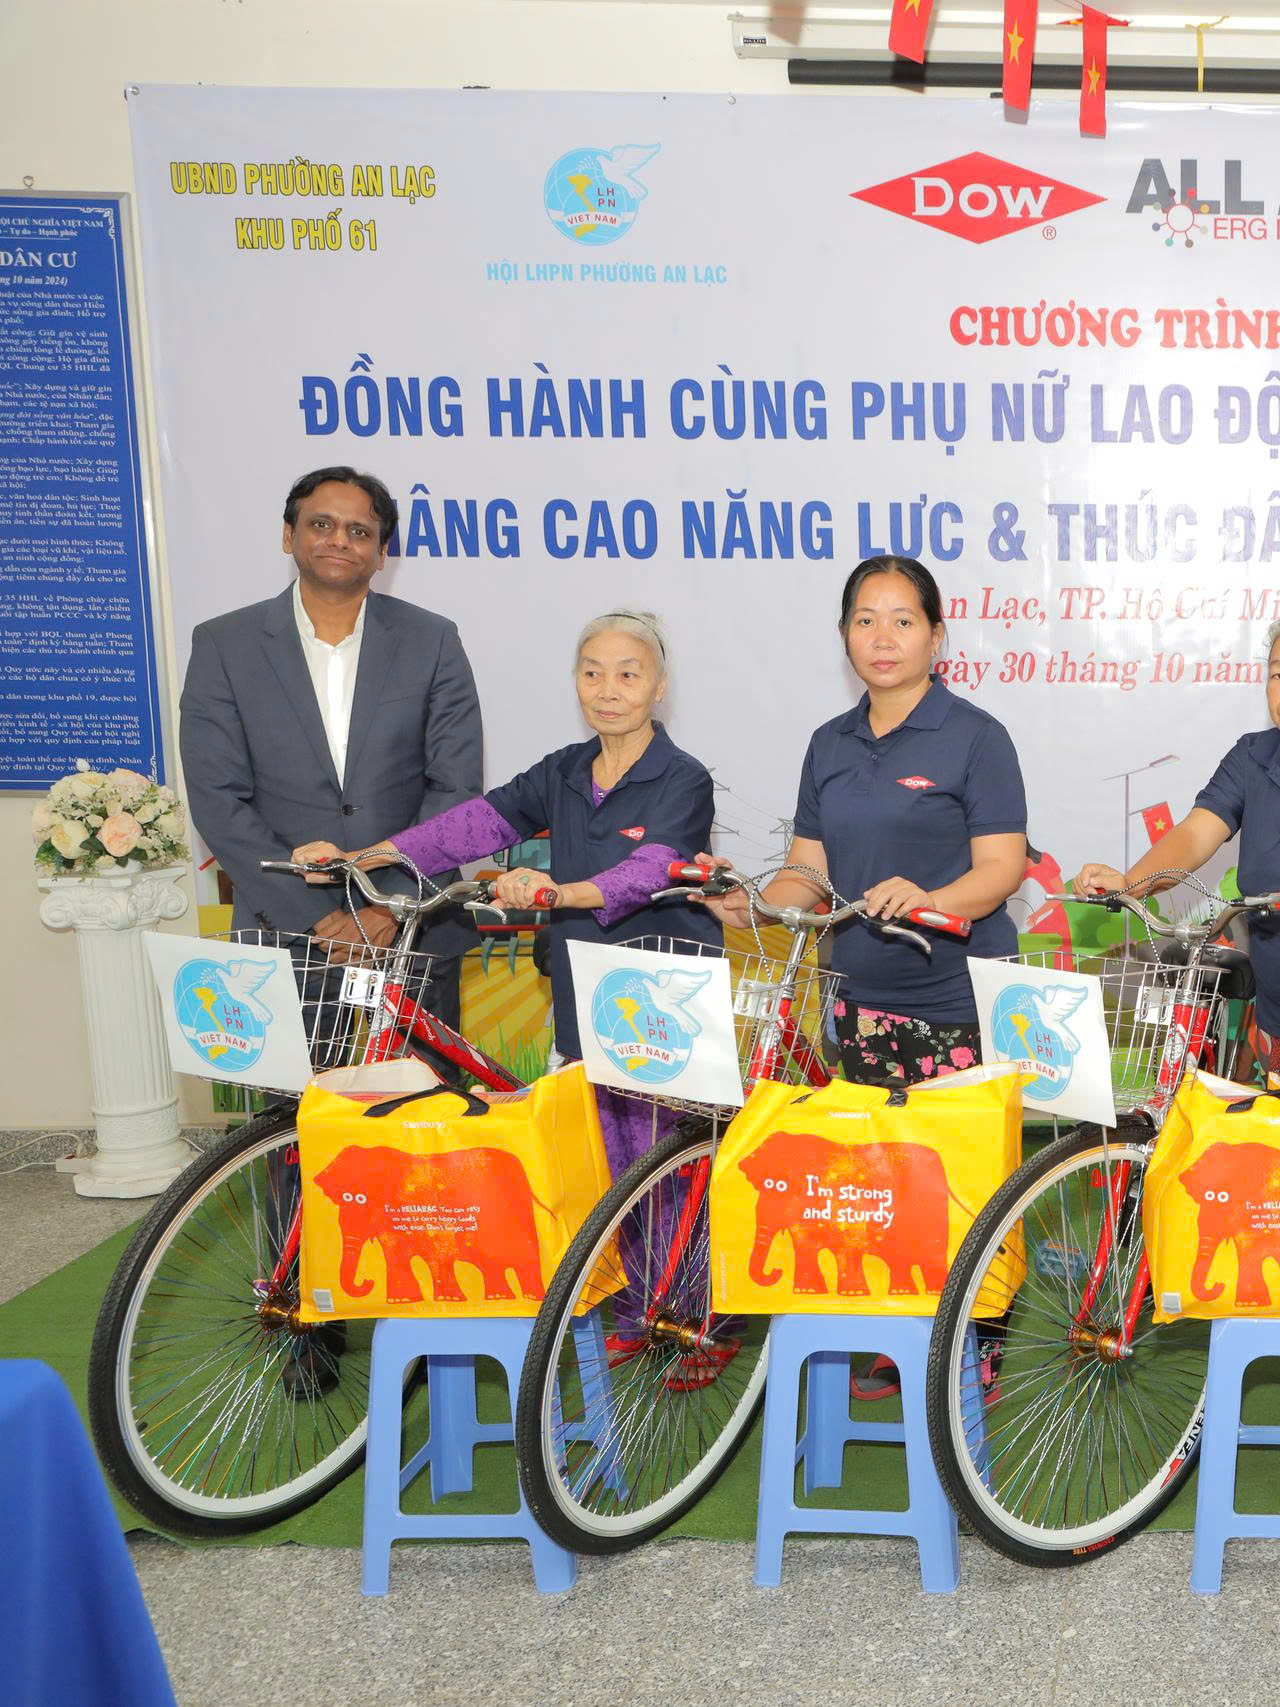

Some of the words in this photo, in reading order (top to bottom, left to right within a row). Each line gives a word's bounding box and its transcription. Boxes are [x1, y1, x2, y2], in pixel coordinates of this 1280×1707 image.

[170, 162, 237, 194] UBND
[244, 156, 344, 196] PHƯỜNG
[352, 165, 383, 197] AN
[390, 166, 435, 204] LẠC
[1126, 159, 1264, 217] ALL
[235, 218, 284, 250] KHU
[292, 208, 342, 251] PHỐ
[349, 219, 377, 251] 61
[594, 214, 617, 225] NAM
[1214, 218, 1267, 240] ERG
[0, 248, 42, 266] DÂN
[48, 251, 77, 268] CƯ
[486, 260, 519, 284] HỘI
[526, 264, 573, 281] LHPN
[580, 263, 656, 282] PHƯỜNG
[664, 265, 686, 283] AN
[694, 265, 727, 286] LẠC
[950, 300, 1140, 347] CHƯƠNG
[299, 353, 463, 437] ĐỒNG
[487, 363, 646, 438] HÀNH
[670, 365, 827, 440] CÙNG
[852, 382, 966, 455] PHỤ
[992, 369, 1070, 443] NỮ
[1091, 384, 1193, 444] LAO
[544, 499, 657, 559] CAO
[682, 489, 833, 560] NĂNG
[988, 502, 1027, 561] &
[1048, 491, 1197, 561] THÚC
[979, 587, 1045, 629] Lạc,
[1059, 588, 1105, 620] TP.
[933, 651, 991, 690] gày
[999, 652, 1035, 683] 30
[1046, 651, 1140, 690] tháng
[1150, 653, 1184, 683] 10
[225, 1035, 248, 1050] NAM
[646, 1047, 670, 1062] NAM
[1035, 1064, 1056, 1078] NAM
[806, 1174, 834, 1197] I'm
[838, 1184, 893, 1207] strong
[803, 1200, 832, 1220] and
[836, 1202, 894, 1230] sturdy
